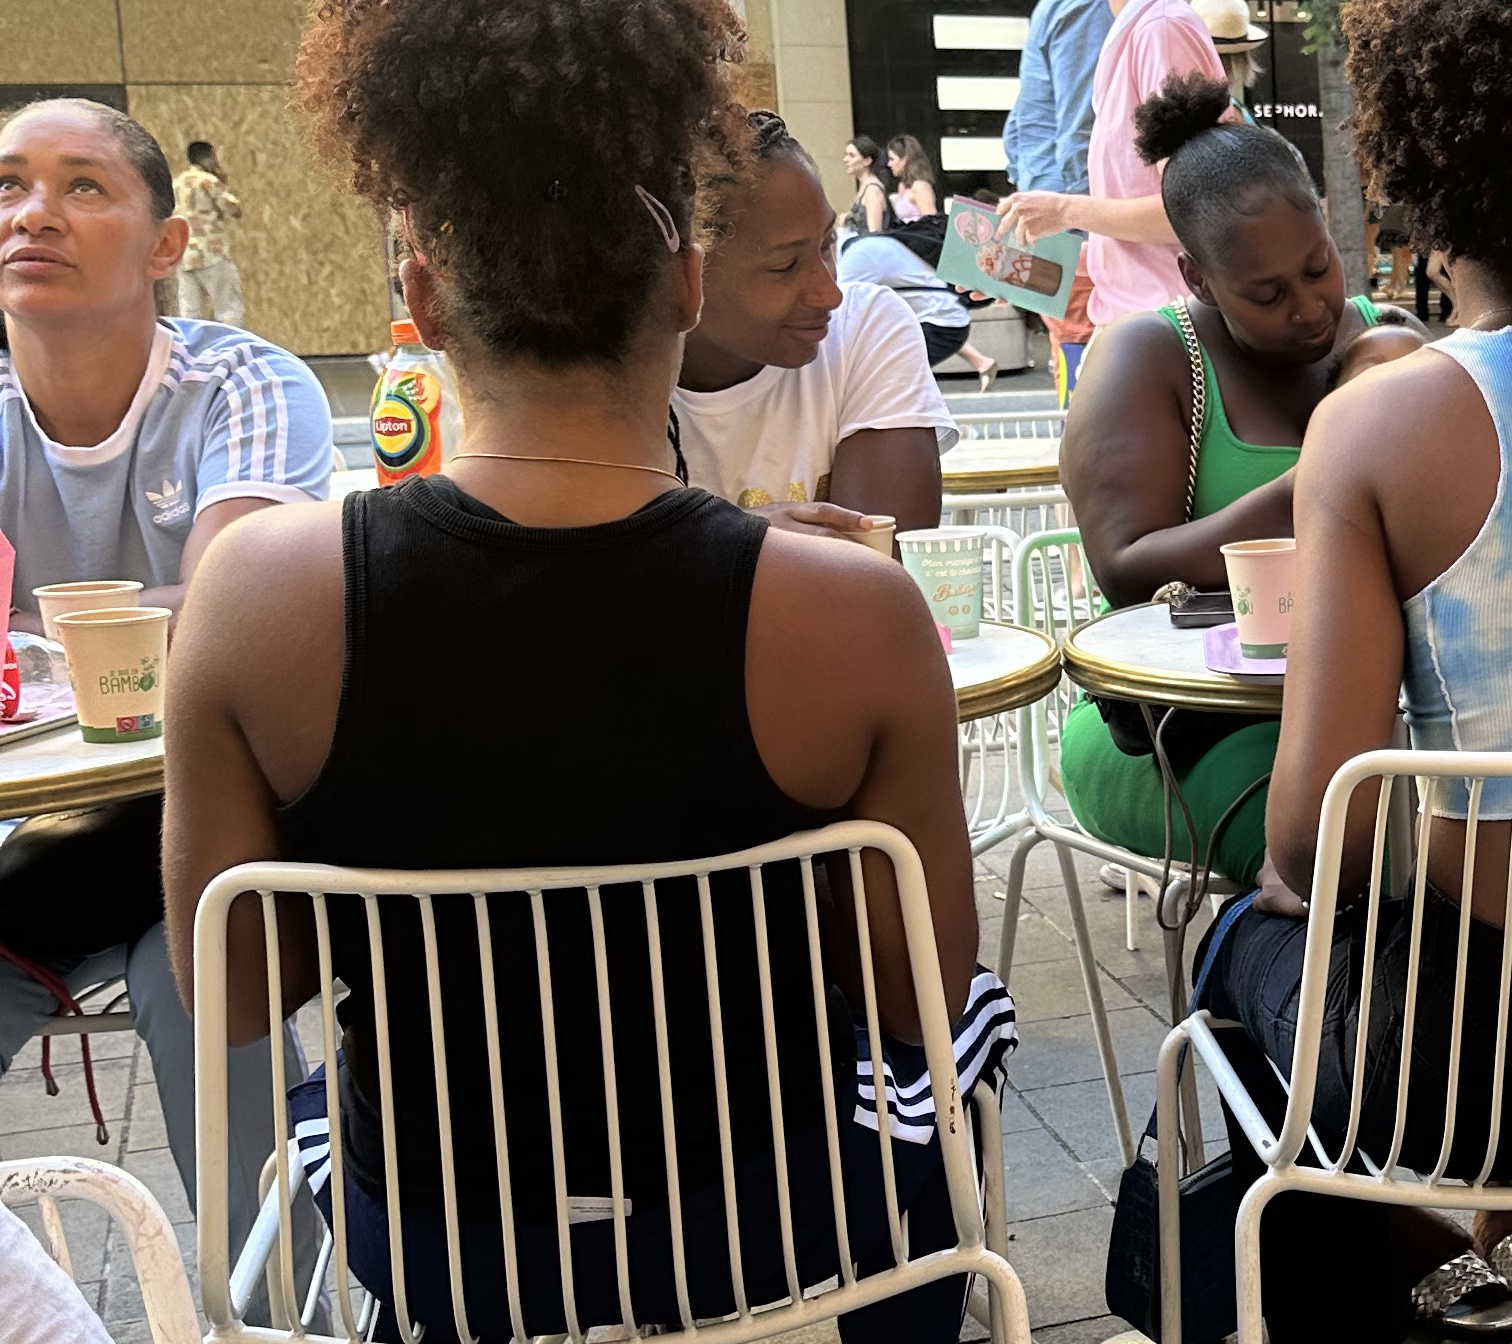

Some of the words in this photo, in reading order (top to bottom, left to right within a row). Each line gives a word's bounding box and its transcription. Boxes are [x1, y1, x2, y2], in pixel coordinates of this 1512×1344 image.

[1253, 103, 1324, 117] SEPHOR
[375, 420, 408, 433] Lipton
[153, 502, 190, 524] adidas
